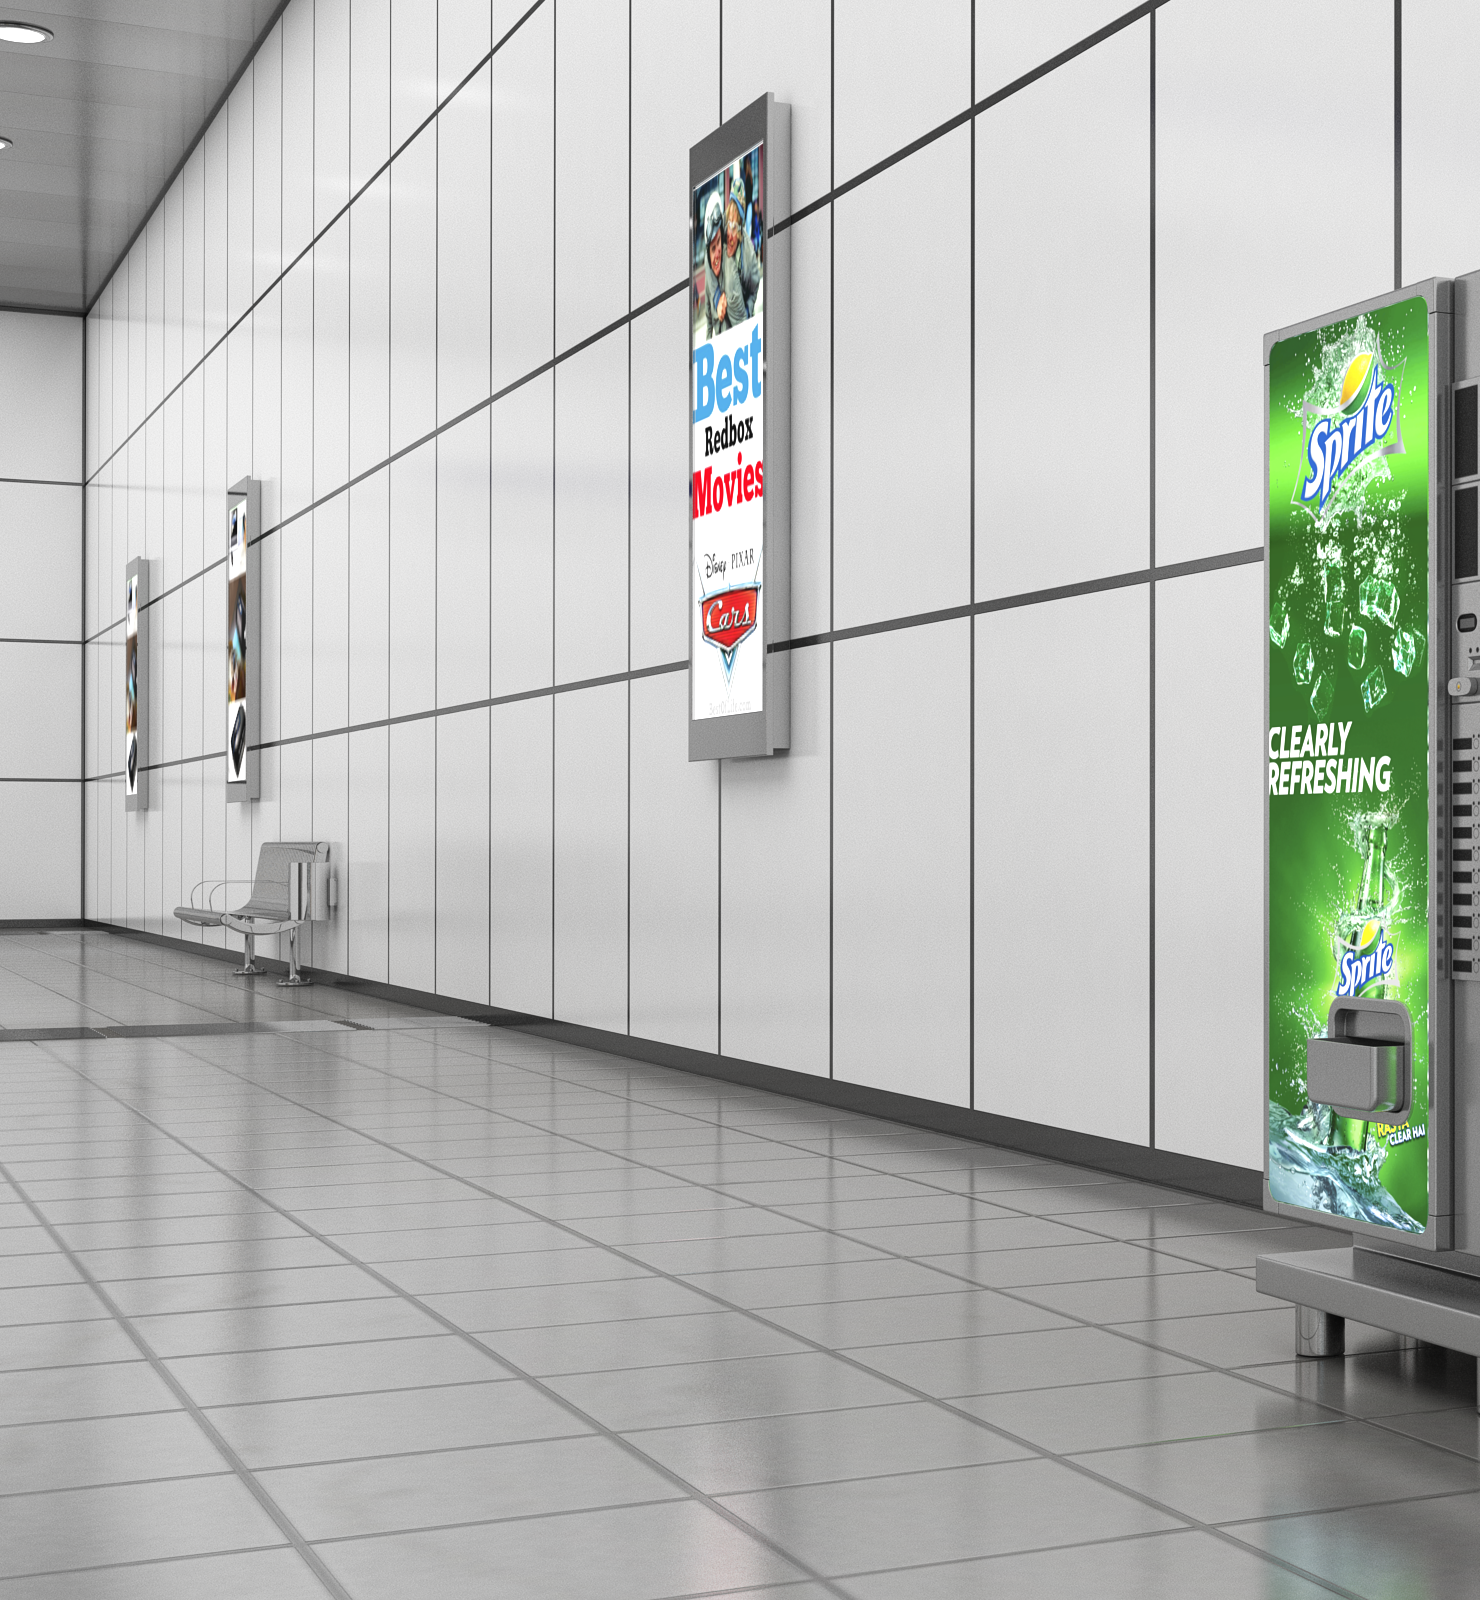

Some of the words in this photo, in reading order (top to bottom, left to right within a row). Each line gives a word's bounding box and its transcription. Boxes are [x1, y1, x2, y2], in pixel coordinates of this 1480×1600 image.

[693, 323, 762, 425] Best
[704, 414, 754, 457] Redbox
[1300, 363, 1395, 515] Sprite
[693, 451, 763, 520] Movies
[731, 548, 755, 570] PIXAR
[706, 600, 752, 634] Cars
[1269, 721, 1353, 760] CLEARLY
[1269, 755, 1392, 796] REFRESHING
[1335, 928, 1394, 997] Sprite
[1389, 1128, 1412, 1146] CLEAR
[1411, 1123, 1426, 1139] HAI
